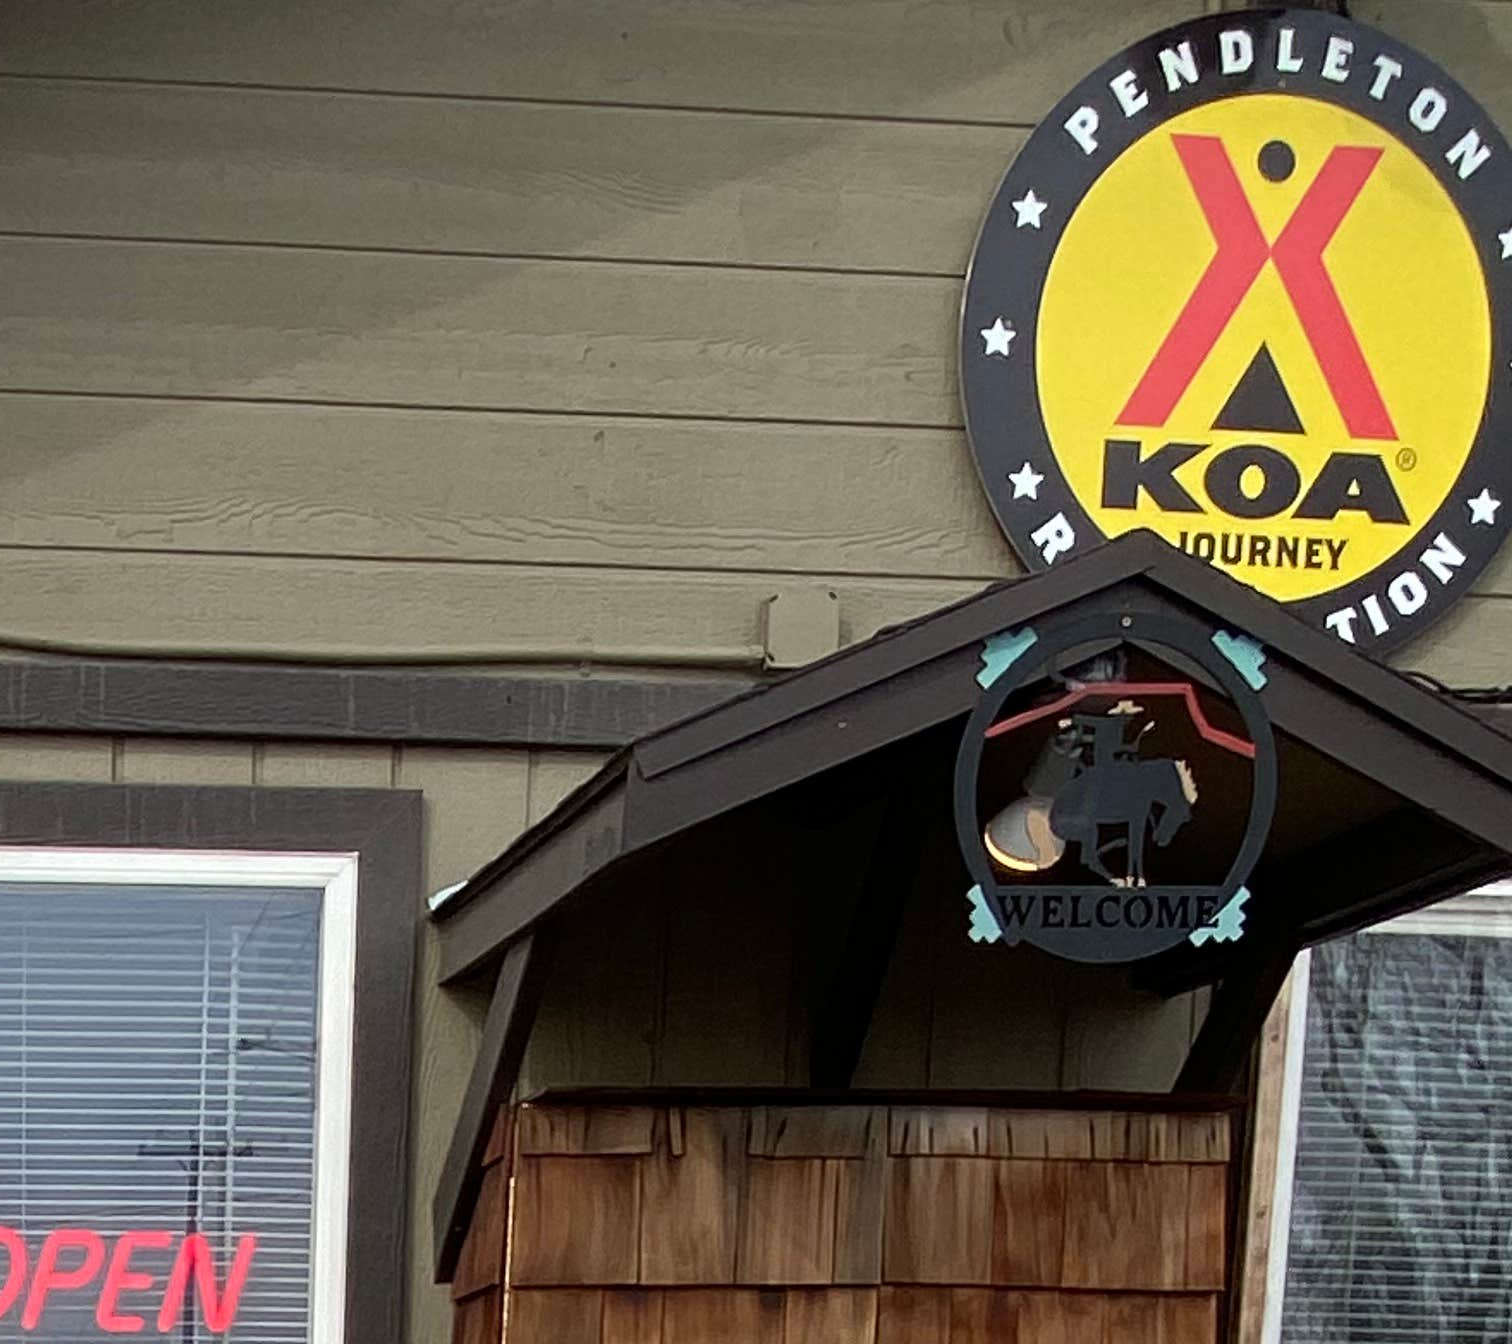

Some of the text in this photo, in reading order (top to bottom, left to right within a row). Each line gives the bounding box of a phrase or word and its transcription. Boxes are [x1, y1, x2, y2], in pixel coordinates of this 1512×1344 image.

[1064, 28, 1491, 180] PENDLETON
[1100, 439, 1410, 526] KOA
[1179, 531, 1349, 571] JOURNEY
[996, 895, 1220, 929] WELCOME
